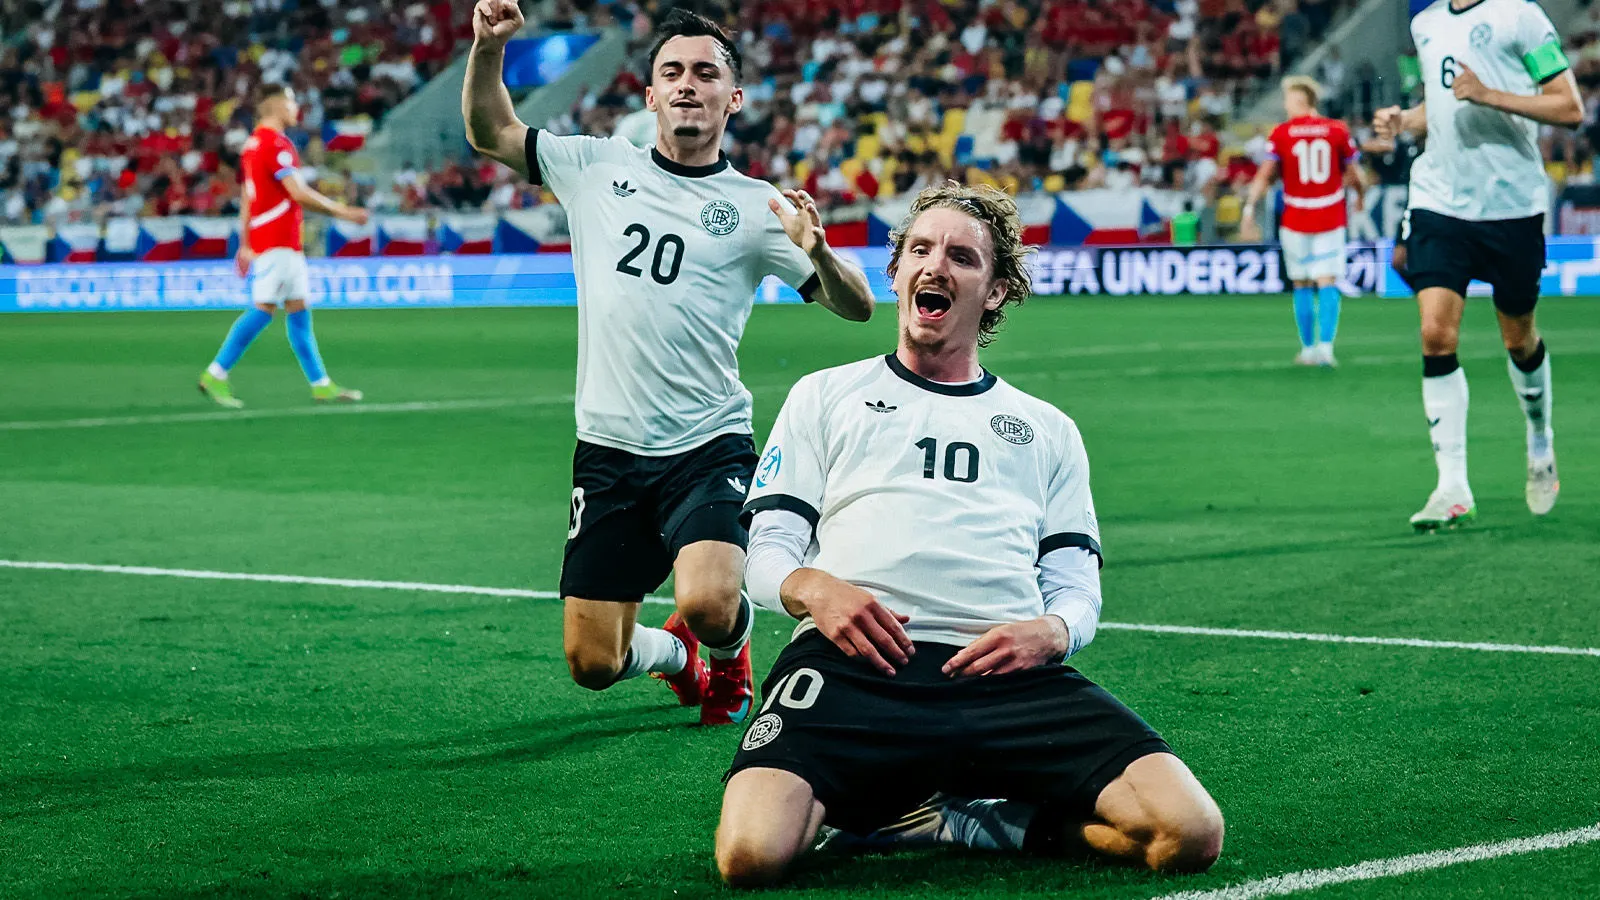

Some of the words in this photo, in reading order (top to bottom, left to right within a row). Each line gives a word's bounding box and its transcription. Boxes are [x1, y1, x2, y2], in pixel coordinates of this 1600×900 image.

[1441, 55, 1456, 89] 6
[1291, 138, 1331, 185] 10
[616, 223, 685, 286] 20
[1032, 251, 1098, 295] EFA
[16, 270, 160, 307] DISCOVER
[914, 436, 980, 484] 10
[759, 667, 825, 715] 10
